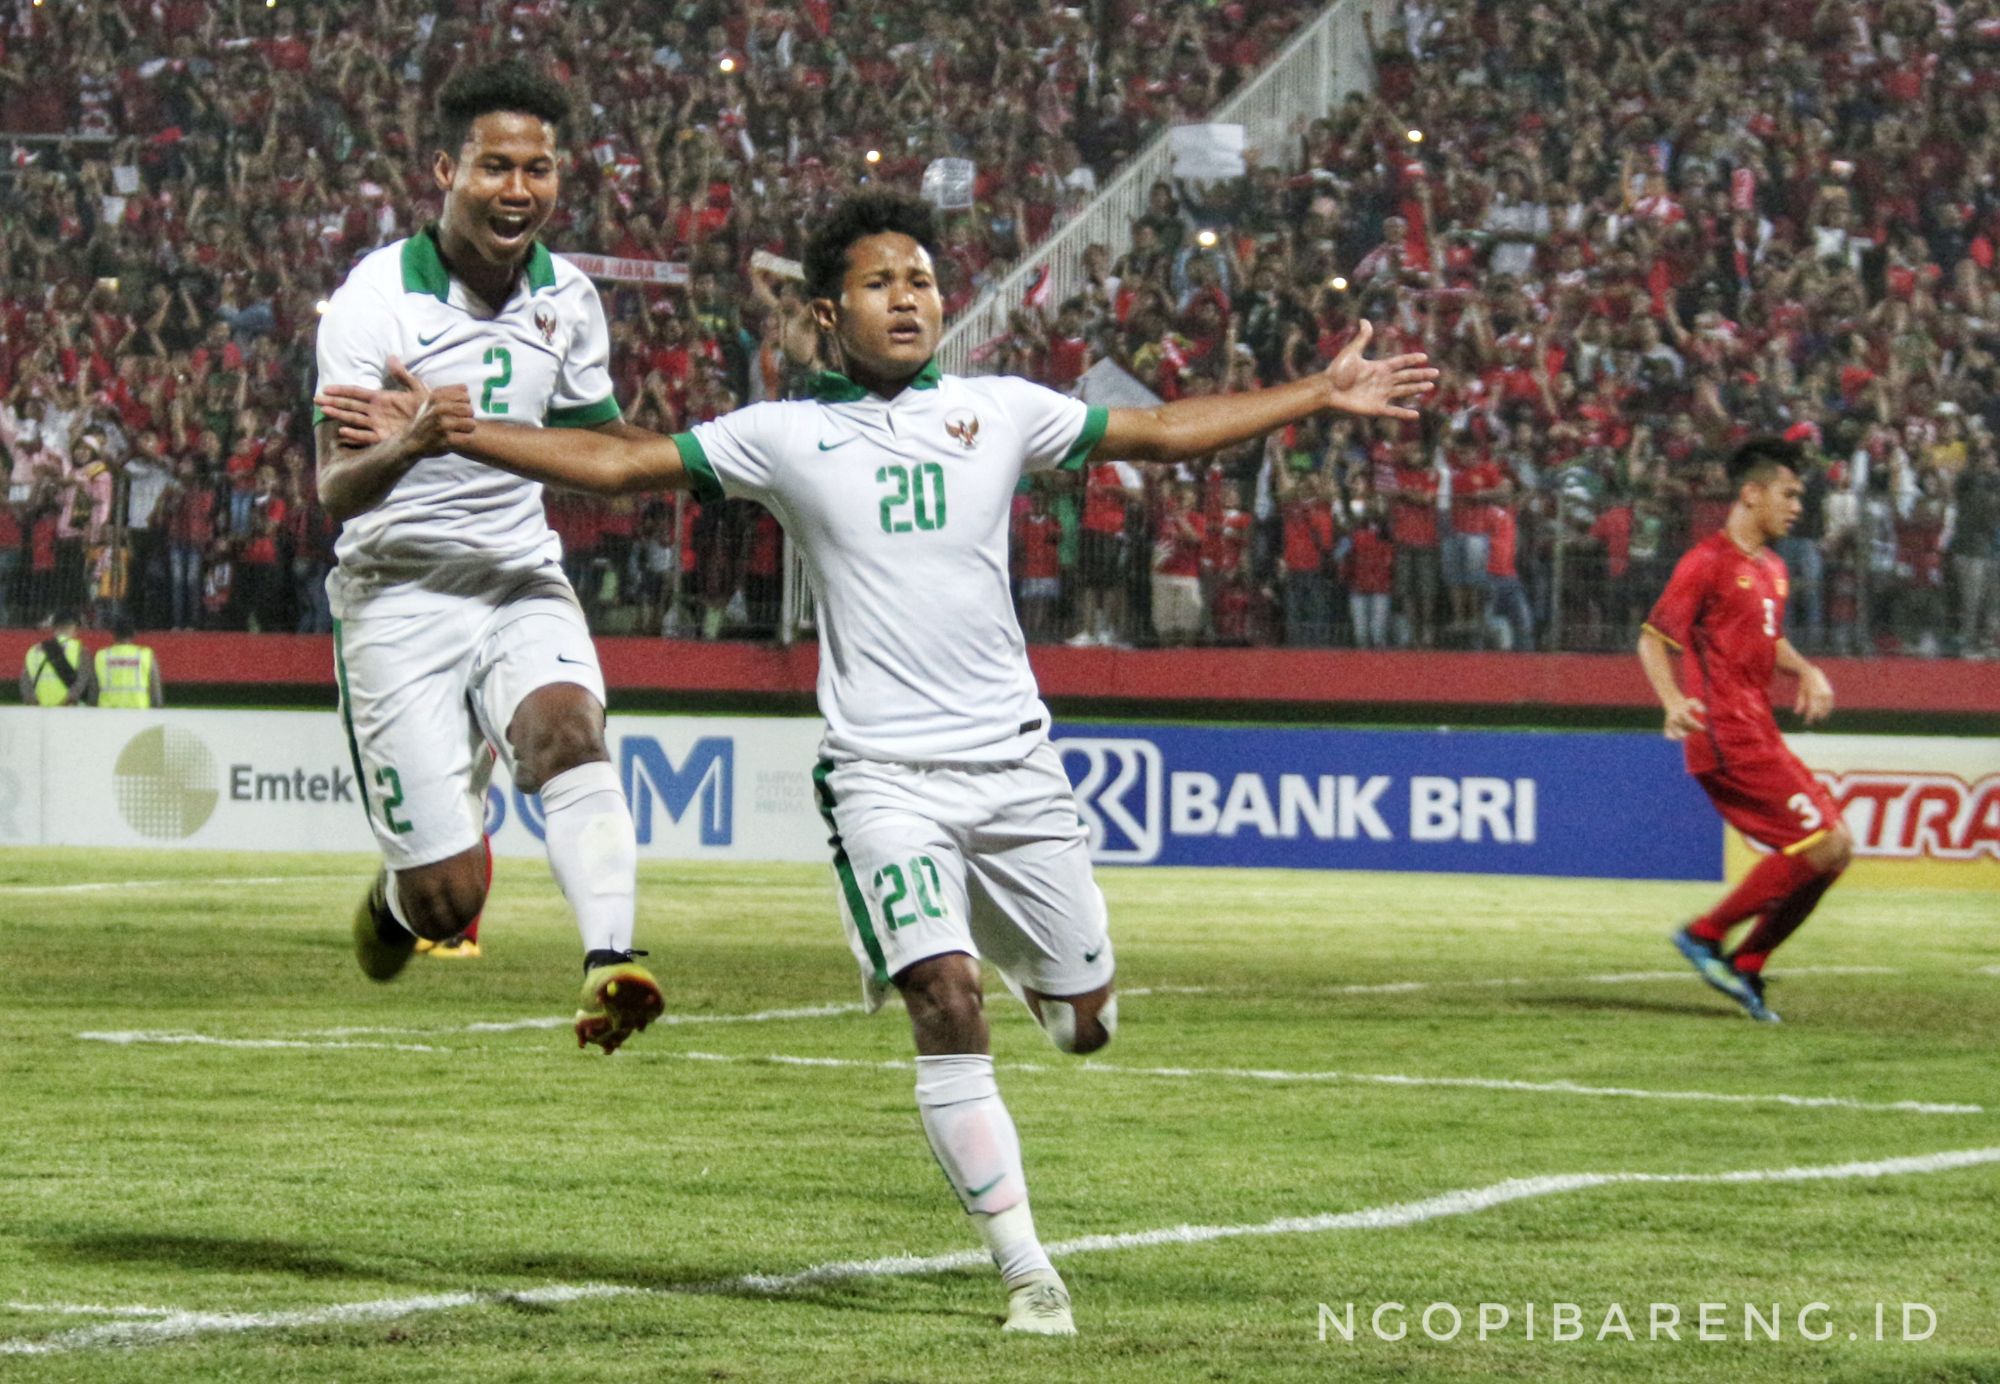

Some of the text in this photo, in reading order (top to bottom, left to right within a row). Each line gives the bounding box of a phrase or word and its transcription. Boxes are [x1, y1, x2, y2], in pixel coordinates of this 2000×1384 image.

[481, 347, 512, 414] 2
[876, 462, 947, 535] 20
[230, 764, 353, 803] Emtek
[374, 766, 414, 834] 2
[1170, 771, 1537, 844] BANK BRI
[1787, 793, 1822, 829] 3
[874, 855, 948, 931] 20
